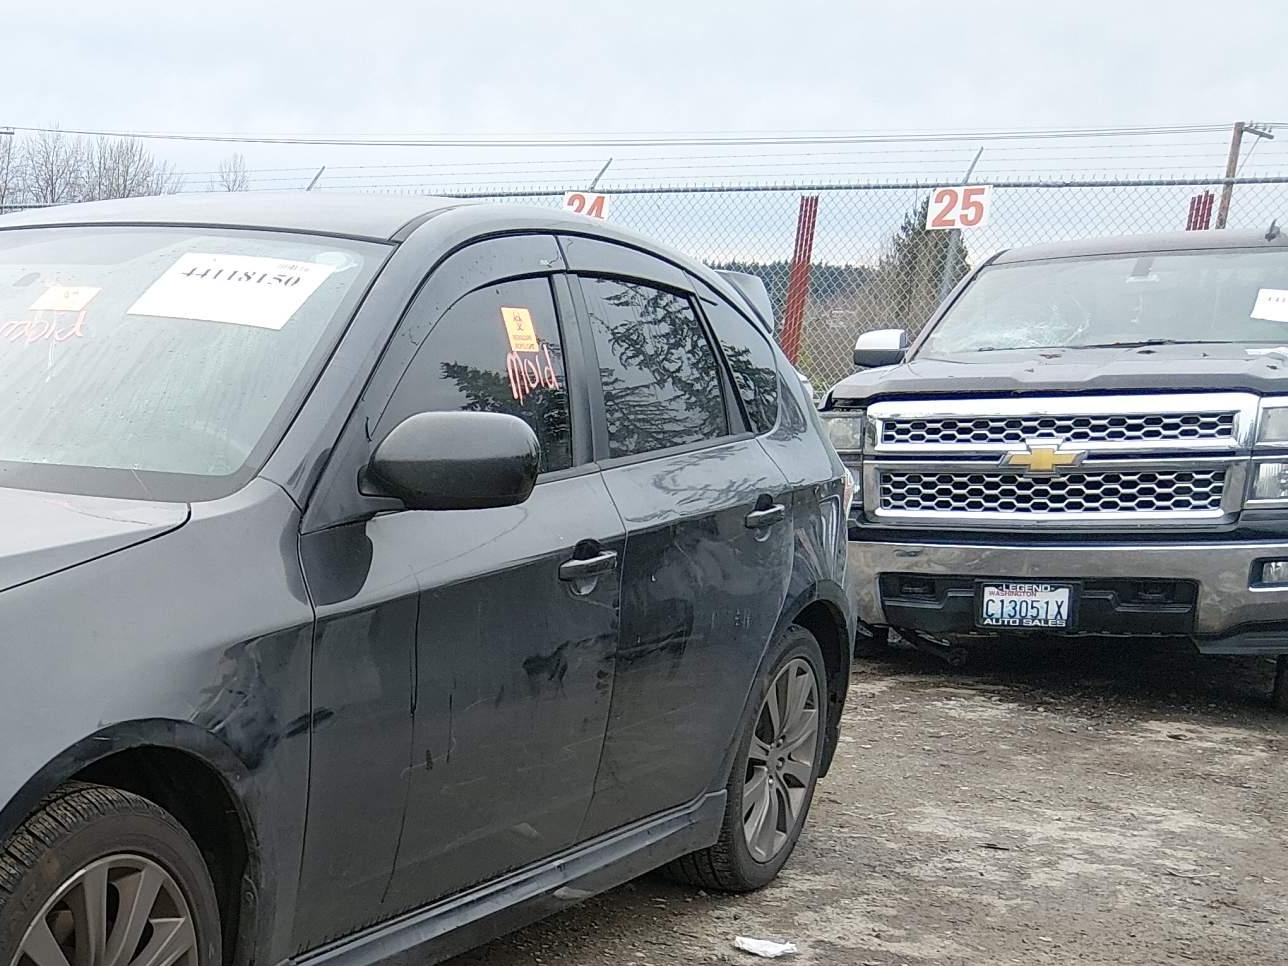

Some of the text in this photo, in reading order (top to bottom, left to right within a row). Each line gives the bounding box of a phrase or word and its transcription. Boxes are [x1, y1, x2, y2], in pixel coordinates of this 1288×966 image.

[931, 187, 986, 227] 25
[179, 266, 302, 288] 44118150
[987, 590, 1038, 598] WASHINGTON
[984, 598, 1065, 620] C13051X
[983, 618, 1066, 627] AUTO SALES
